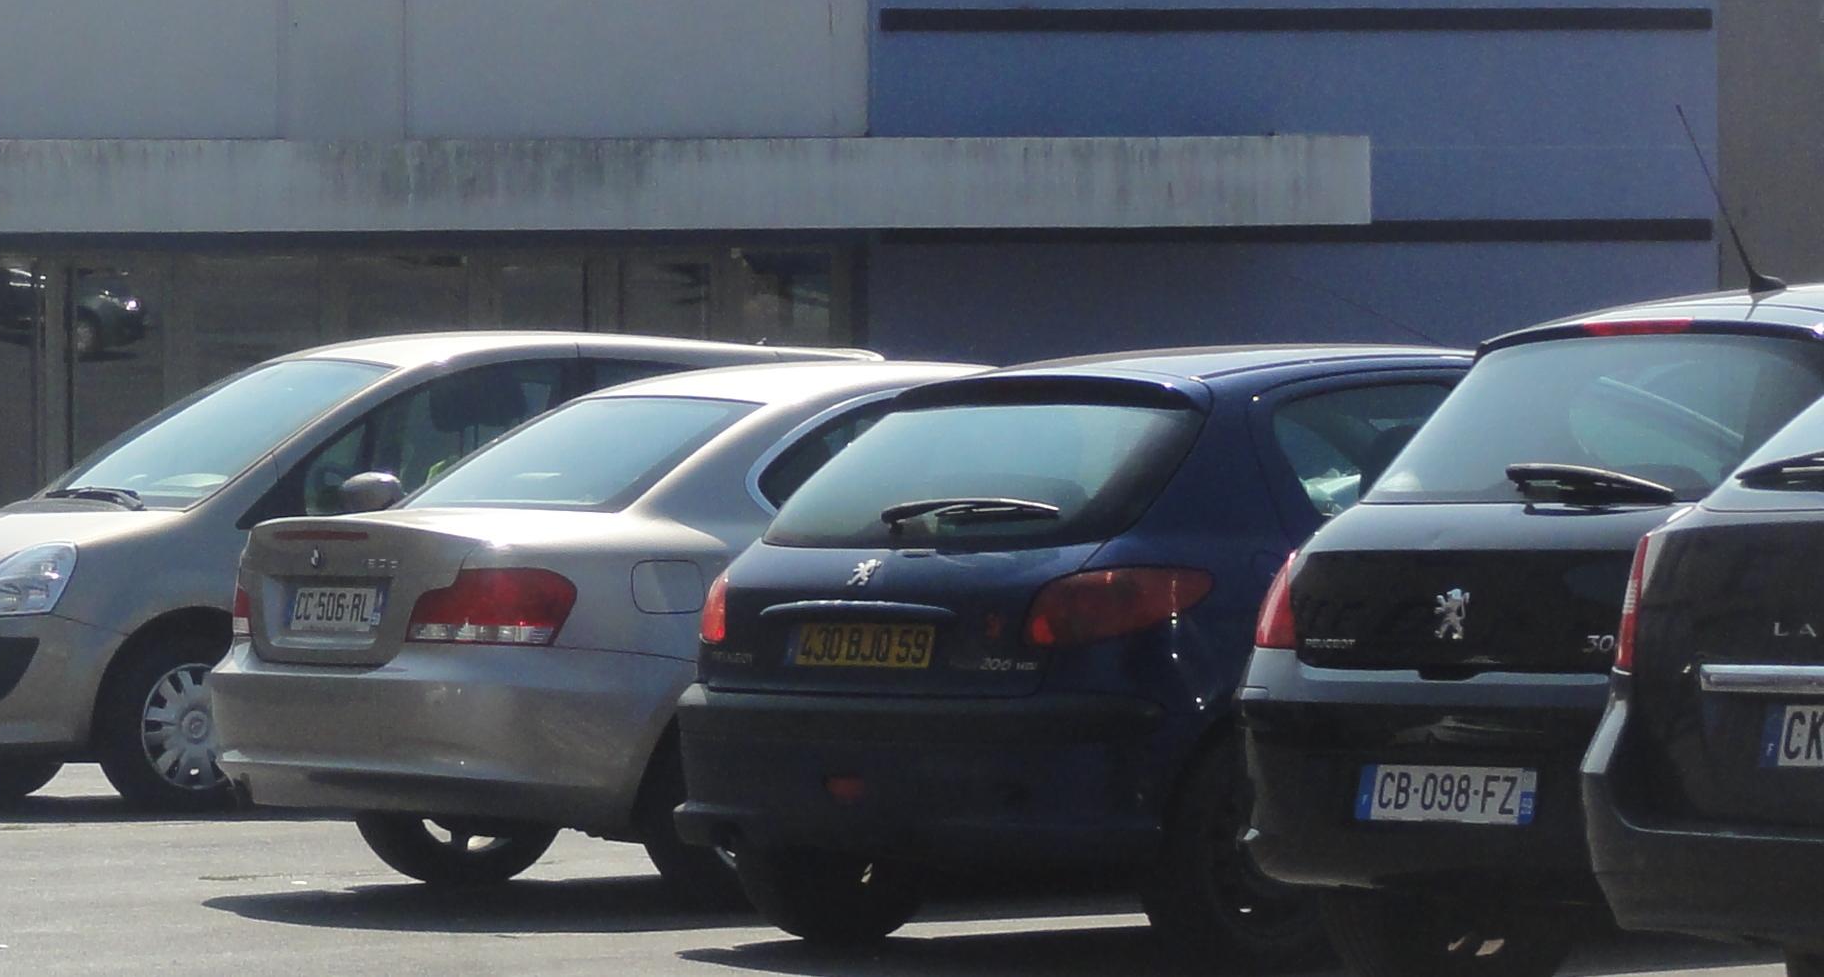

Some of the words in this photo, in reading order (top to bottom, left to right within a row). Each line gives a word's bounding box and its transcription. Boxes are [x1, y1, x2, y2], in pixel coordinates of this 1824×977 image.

[896, 629, 929, 664] 59
[1582, 634, 1616, 653] 30
[979, 656, 1012, 671] 206
